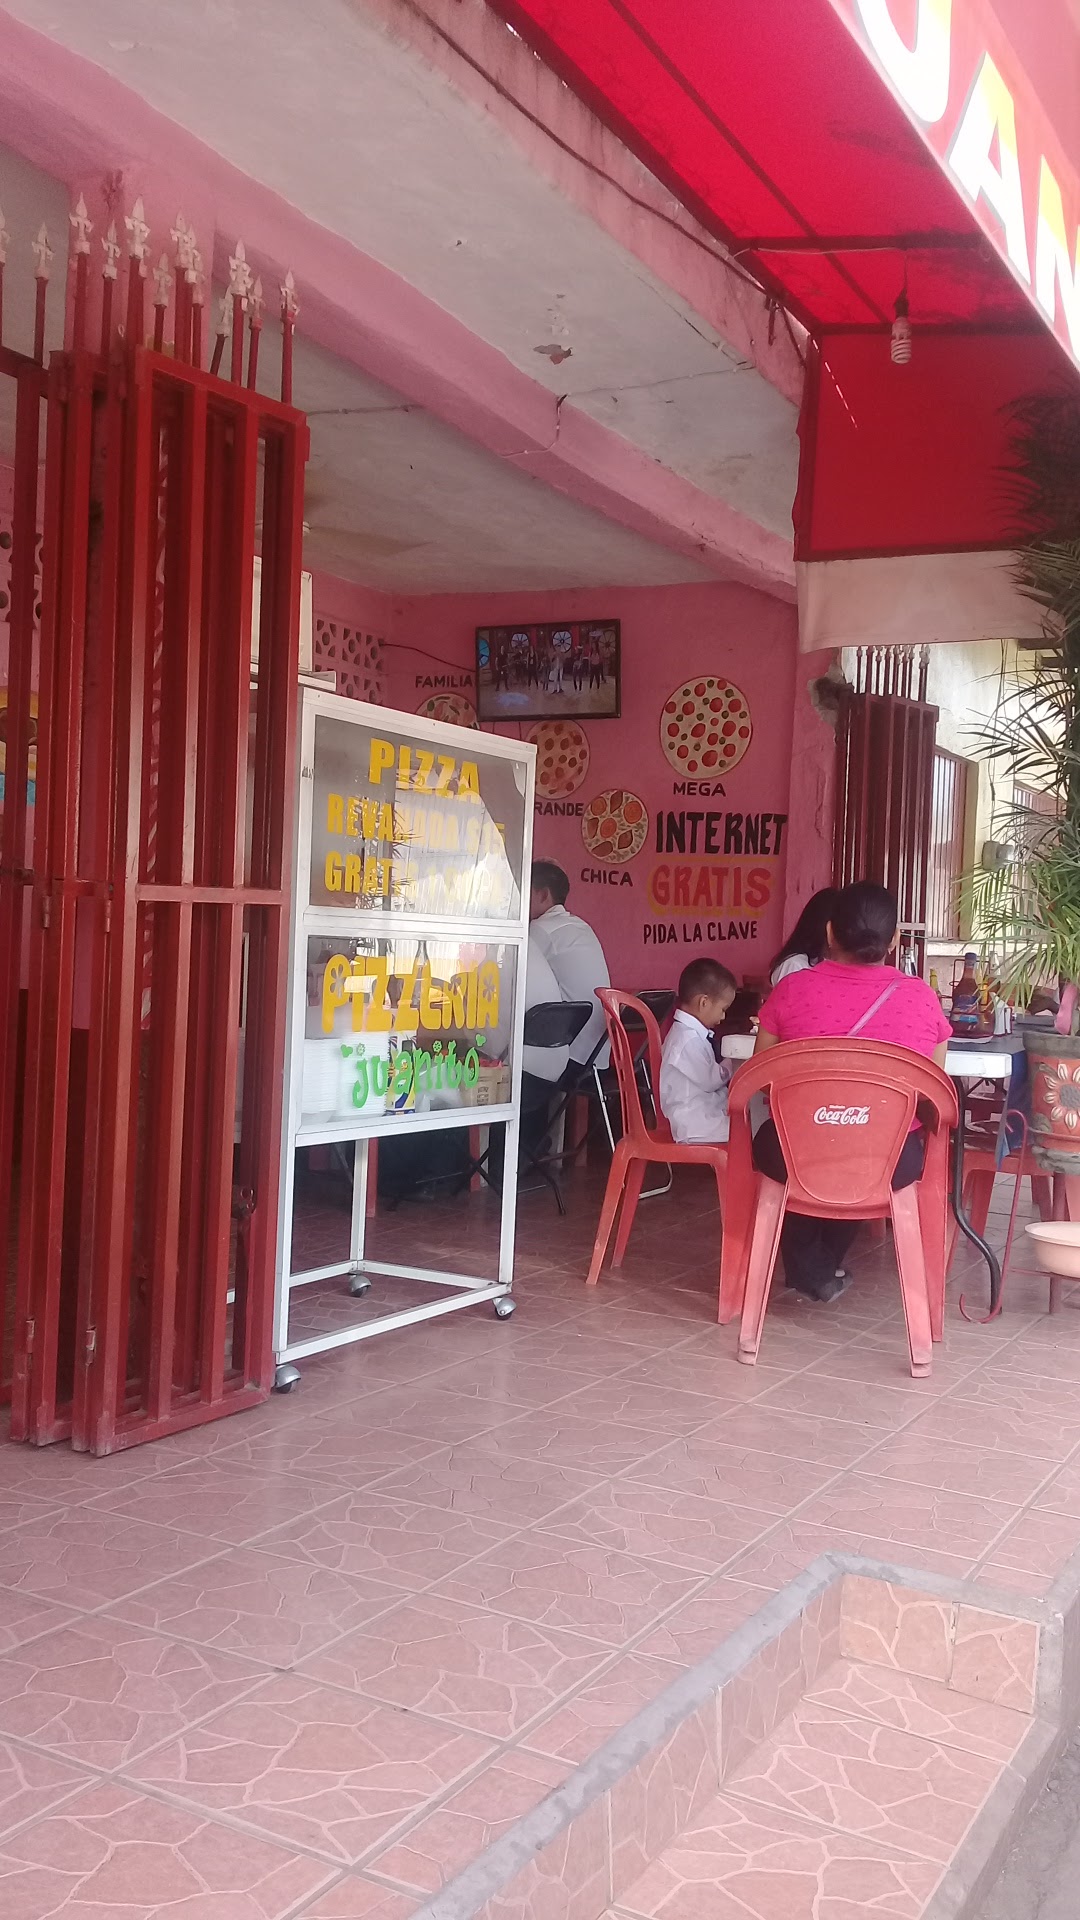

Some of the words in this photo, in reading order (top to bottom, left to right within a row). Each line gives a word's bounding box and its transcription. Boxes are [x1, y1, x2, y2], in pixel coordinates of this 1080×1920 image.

[368, 737, 481, 805] PIZZA
[673, 782, 726, 797] MEGA
[326, 792, 459, 851] REVANADA
[655, 810, 788, 855] INTERNET
[324, 850, 419, 900] GRATIS
[580, 867, 634, 887] CHICA
[650, 864, 772, 909] GRATIS
[643, 923, 677, 945] PIDA
[682, 923, 703, 943] LA
[707, 921, 758, 941] CLAVE
[321, 953, 500, 1034] PIZZERIA
[351, 1040, 481, 1109] juanito
